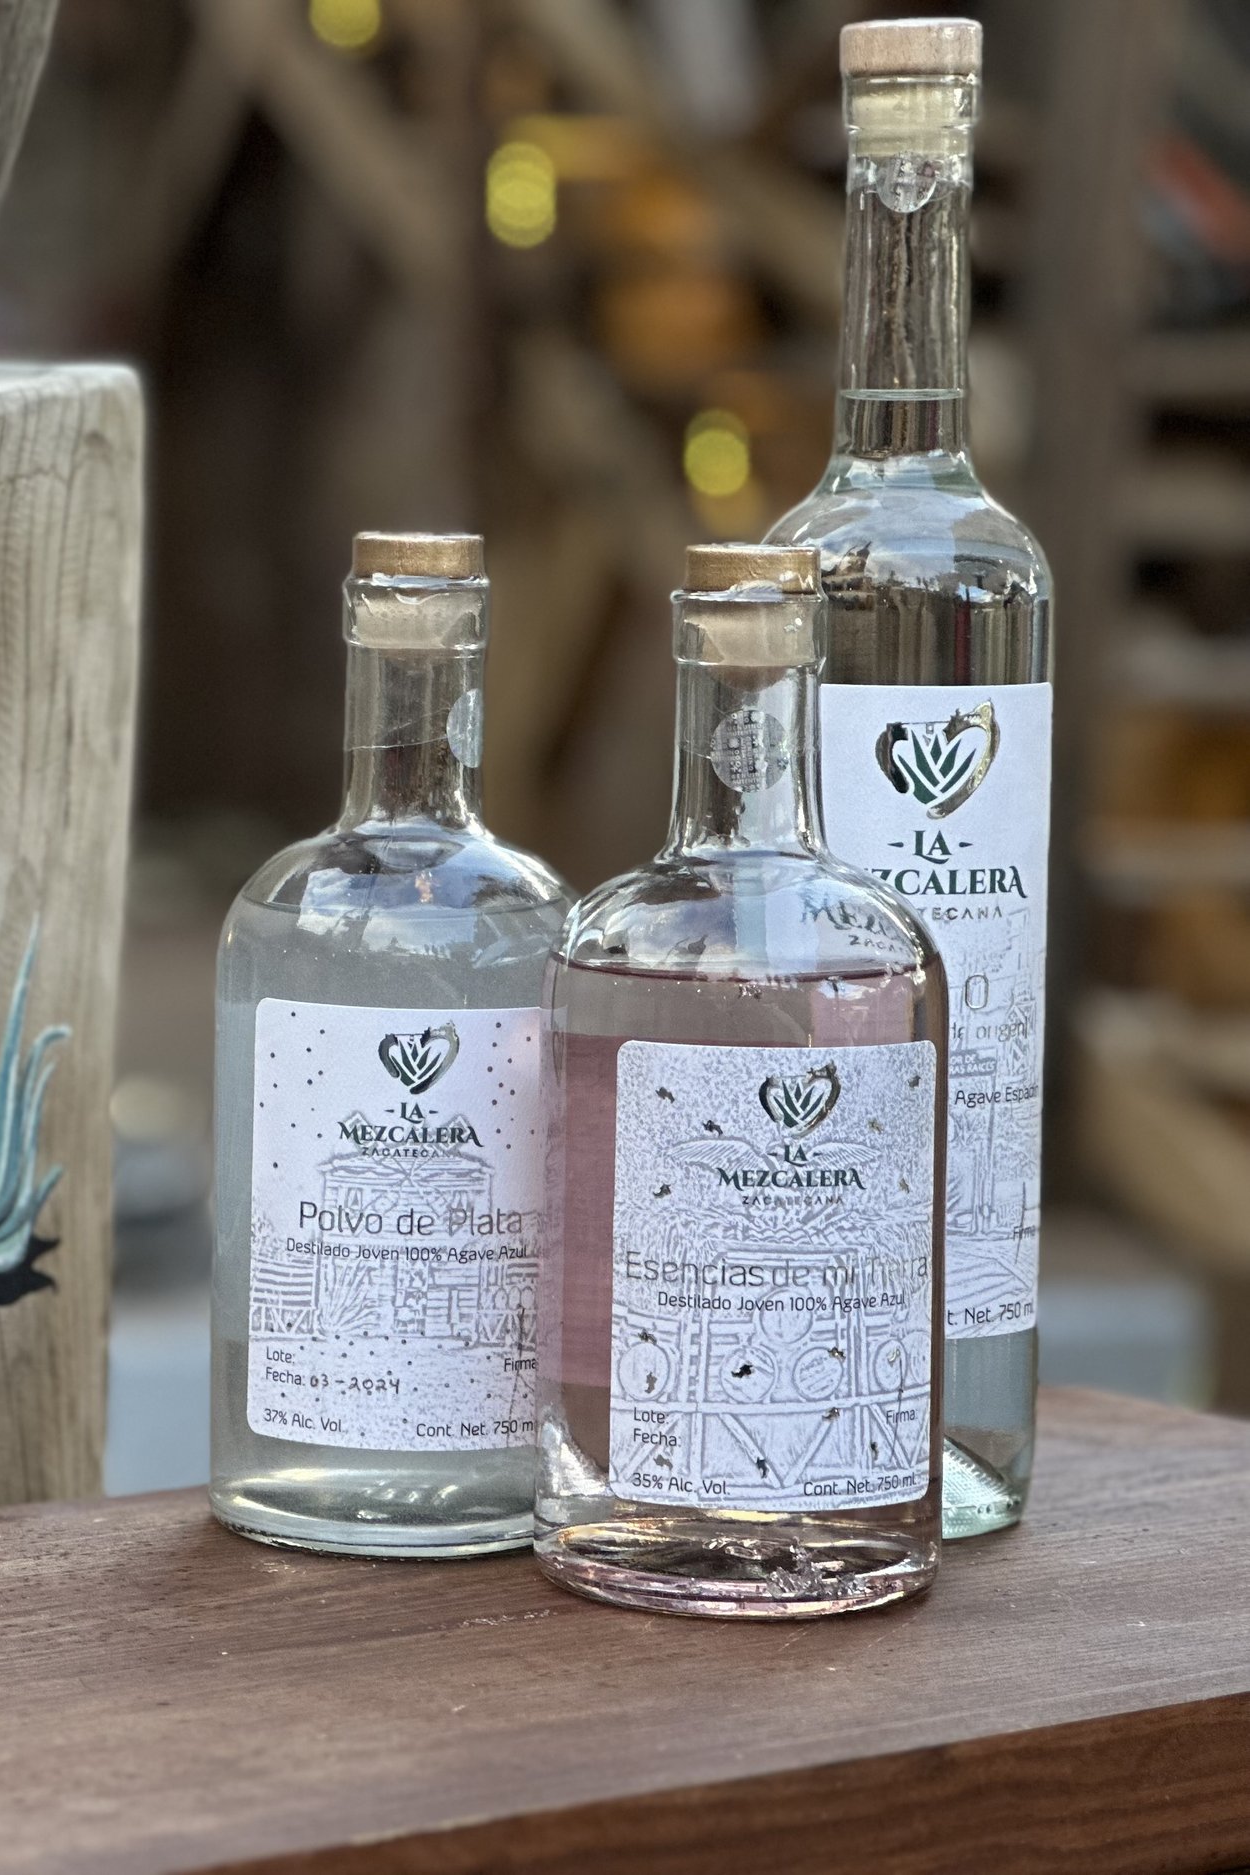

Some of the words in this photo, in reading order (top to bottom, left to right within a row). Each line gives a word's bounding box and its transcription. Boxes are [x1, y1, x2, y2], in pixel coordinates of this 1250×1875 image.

[913, 830, 953, 864] LA
[865, 866, 1028, 898] ZCALERA
[954, 1089, 1002, 1108] Agave
[400, 1102, 425, 1124] LA
[337, 1121, 484, 1148] MEZCALERA
[784, 1144, 808, 1168] LA
[716, 1167, 867, 1191] MEZCALERA
[299, 1201, 383, 1234] Polvo
[397, 1208, 435, 1236] de
[449, 1206, 523, 1236] Plata
[286, 1238, 350, 1258] Destilado
[355, 1246, 399, 1261] Joven
[405, 1247, 442, 1261] 100%
[448, 1247, 494, 1264] Agave
[499, 1244, 527, 1259] Azul
[626, 1250, 764, 1287] Esencias
[772, 1259, 810, 1288] de
[823, 1264, 855, 1287] mi
[658, 1291, 731, 1310] Destilado
[737, 1296, 784, 1311] Joven
[789, 1296, 827, 1311] 100%
[832, 1296, 876, 1313] Agave
[880, 1290, 905, 1307] Azul
[999, 1301, 1021, 1321] 750
[266, 1346, 295, 1364] Lote:
[265, 1367, 306, 1387] Fecha:
[263, 1408, 288, 1425] 37%
[291, 1413, 316, 1430] Alc.
[633, 1406, 670, 1425] Lote:
[886, 1408, 918, 1425] Firma:
[460, 1422, 489, 1436] Net.
[493, 1419, 518, 1435] 750
[633, 1428, 682, 1448] Fecha:
[631, 1472, 663, 1490] 35%
[668, 1476, 697, 1493] Alc.
[702, 1479, 731, 1495] Vol.
[803, 1481, 842, 1496] Cont.
[846, 1480, 875, 1494] Net.
[877, 1474, 898, 1491] 750
[902, 1471, 917, 1487] ml
